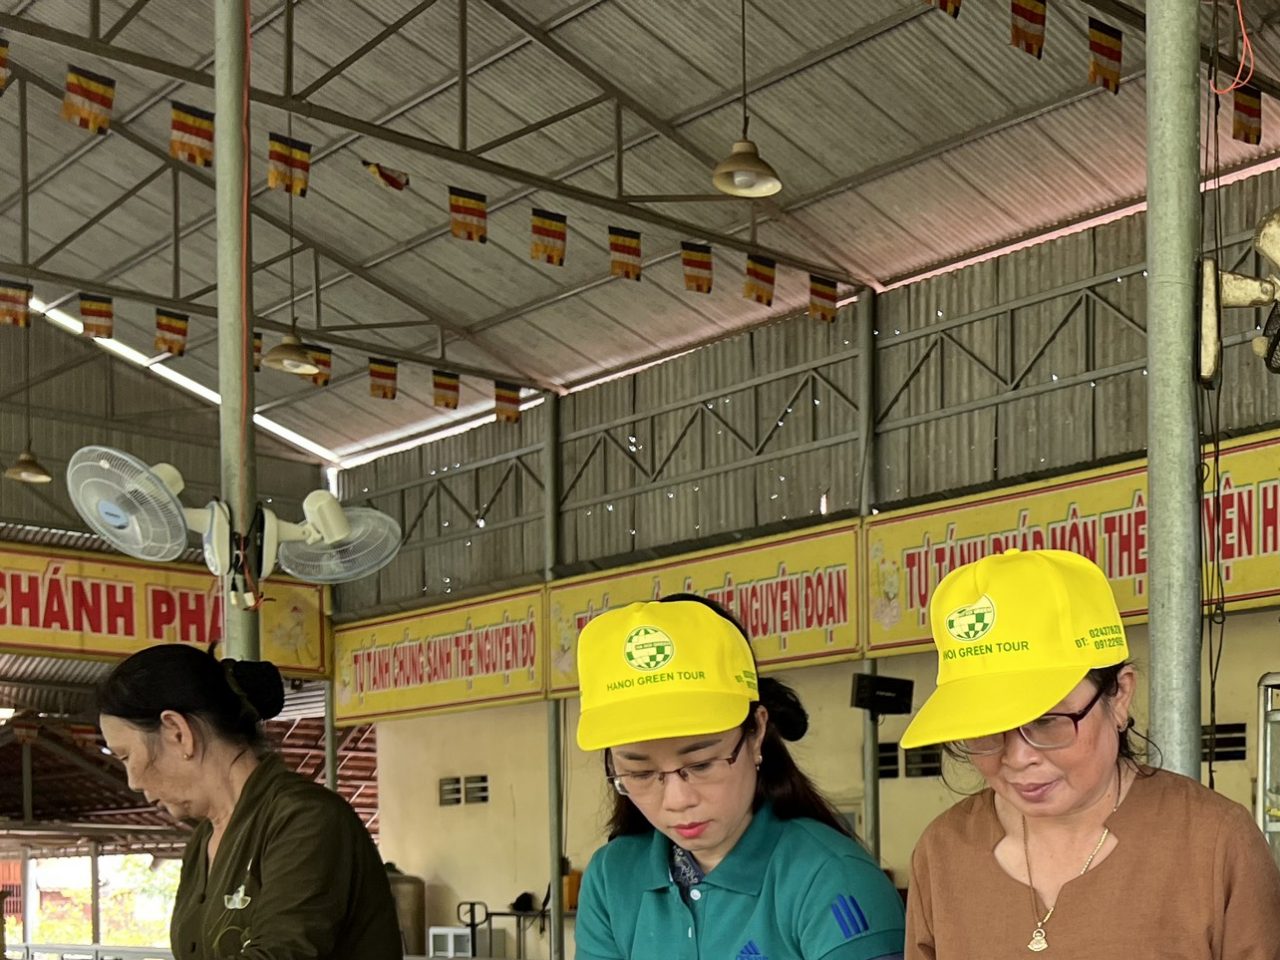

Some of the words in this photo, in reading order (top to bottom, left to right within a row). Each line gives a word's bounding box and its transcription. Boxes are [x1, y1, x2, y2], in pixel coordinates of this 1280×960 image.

[1104, 494, 1147, 594] THỆ
[739, 567, 799, 649] NGUYỆN
[804, 569, 847, 642] ĐOẠN
[959, 644, 993, 658] GREEN
[996, 640, 1029, 653] TOUR
[606, 678, 635, 692] HANOI
[638, 672, 674, 686] GREEN
[678, 671, 705, 681] TOUR
